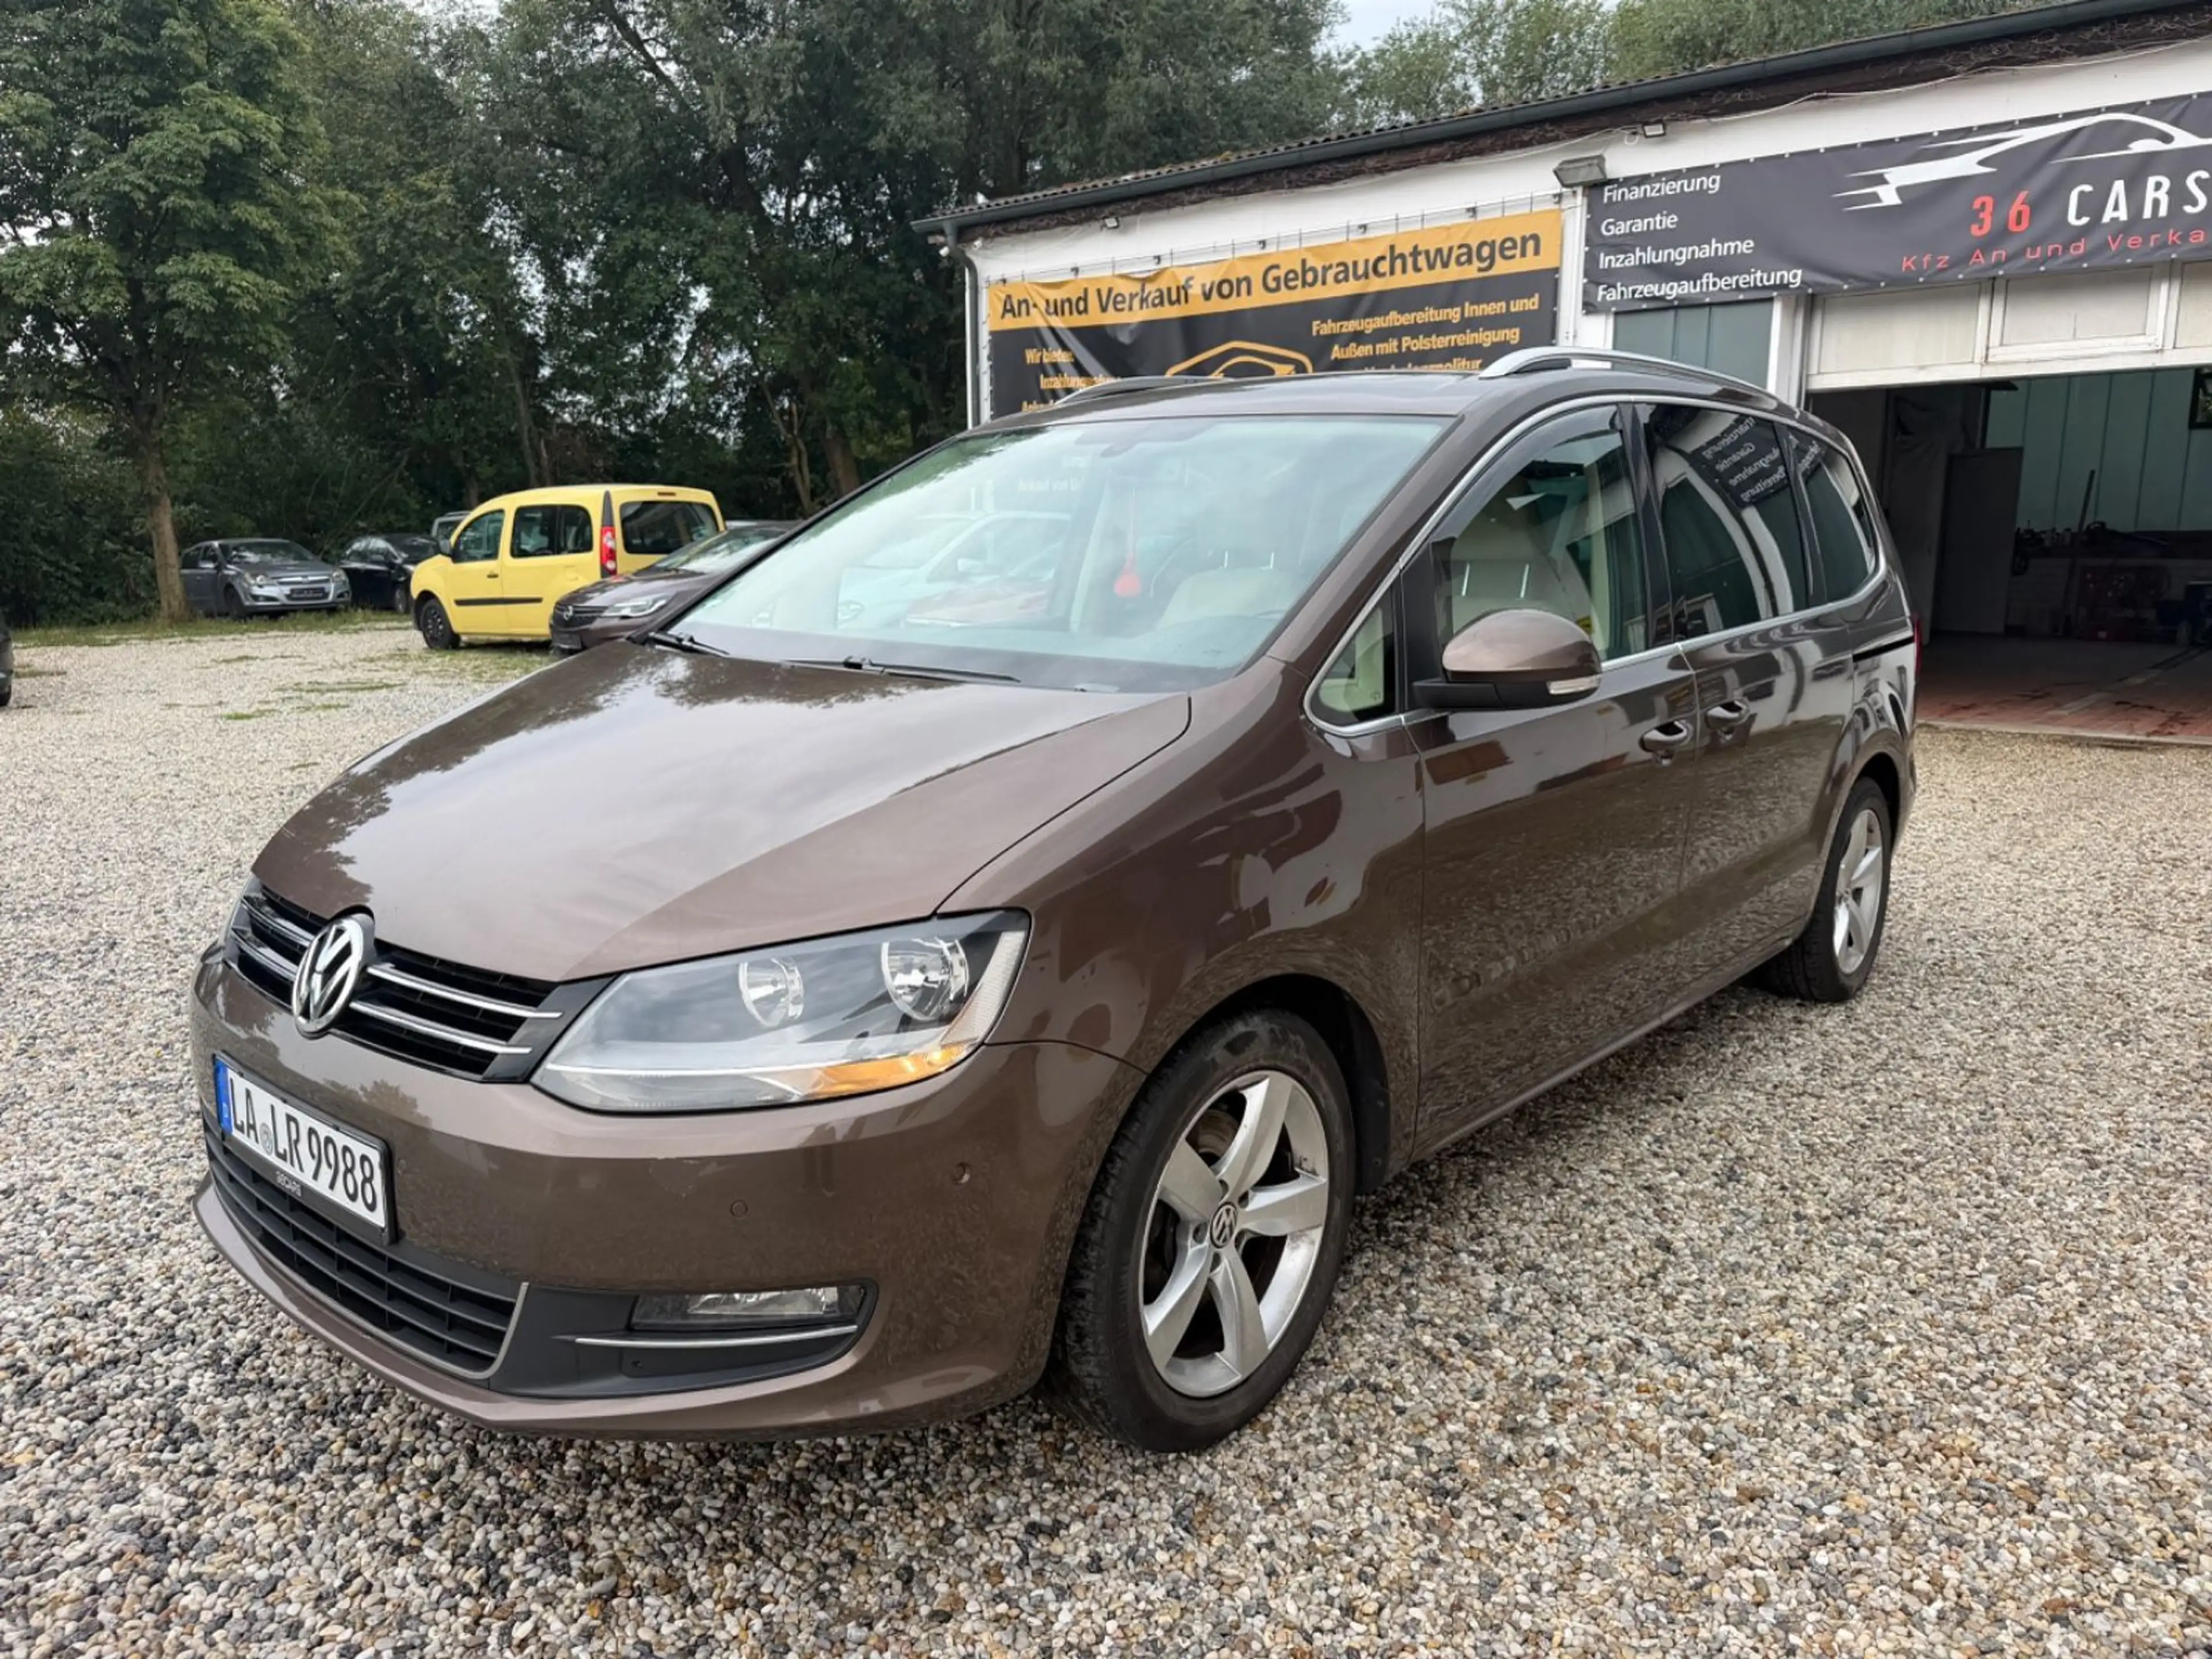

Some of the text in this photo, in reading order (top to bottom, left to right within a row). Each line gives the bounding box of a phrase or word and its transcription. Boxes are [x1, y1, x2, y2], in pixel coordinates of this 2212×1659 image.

[1603, 175, 1721, 204] Finanzierung
[1971, 170, 2210, 237] 36 CARS
[1601, 211, 1679, 236] Garantie
[1599, 238, 1755, 269] Inzahlungnahme
[1902, 229, 2206, 271] Kfz An und Verka
[1044, 288, 1088, 316] und
[1096, 276, 1193, 313] Verkauf
[1201, 275, 1252, 302] von
[1262, 232, 1541, 293] Gebrauchtwagen
[1597, 268, 1802, 302] Fahrzeugaufbereitung
[1312, 293, 1539, 336] Fahrzeugaufbereitung Innen und
[1331, 326, 1521, 361] Außen mit Polsterreinigung
[230, 1078, 259, 1145] LA
[271, 1104, 305, 1173] LR
[307, 1127, 377, 1213] 9988
